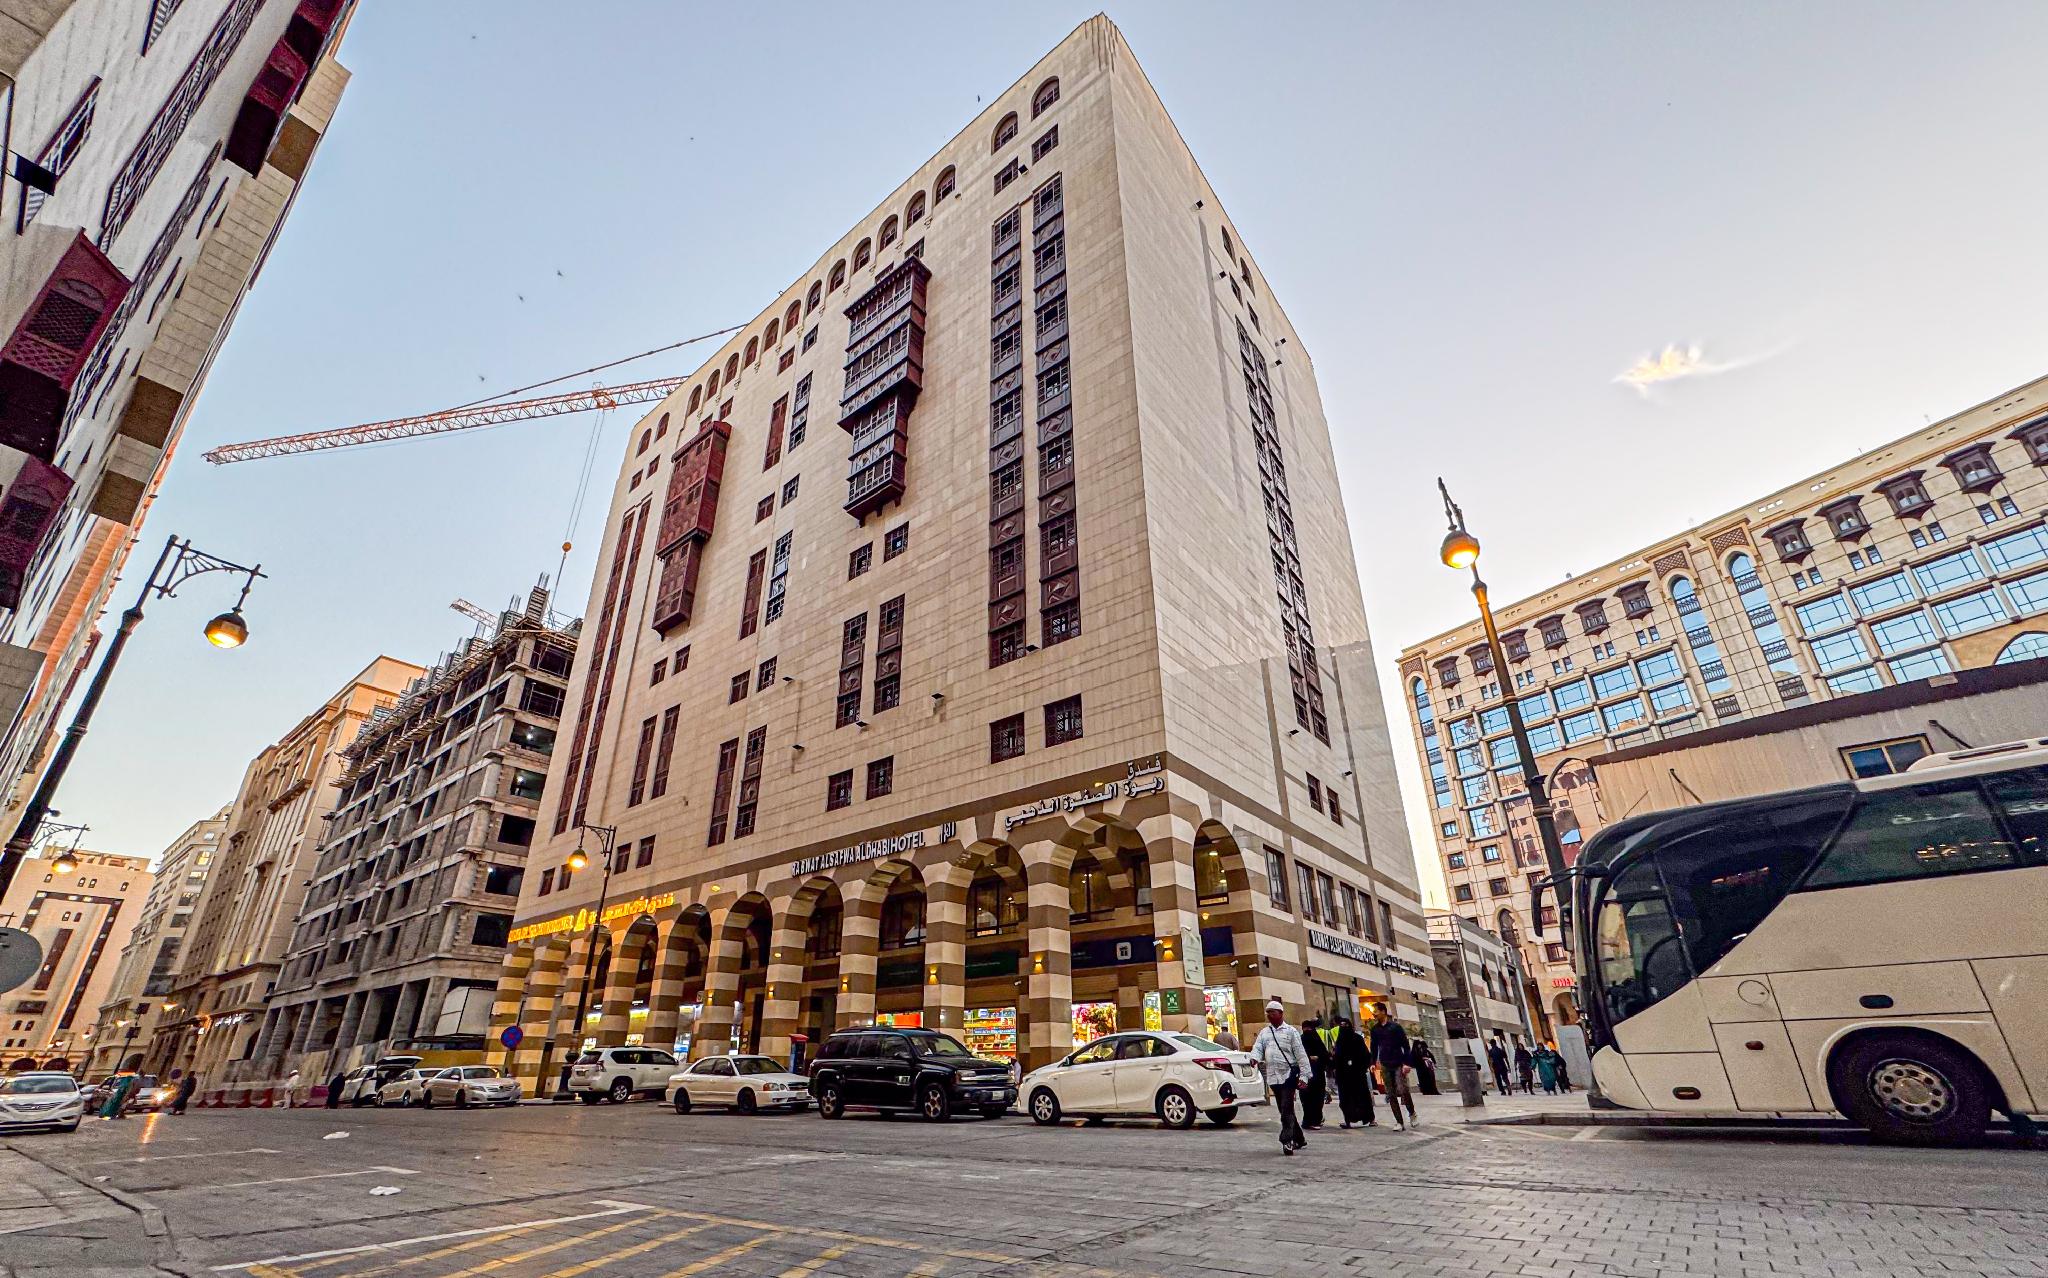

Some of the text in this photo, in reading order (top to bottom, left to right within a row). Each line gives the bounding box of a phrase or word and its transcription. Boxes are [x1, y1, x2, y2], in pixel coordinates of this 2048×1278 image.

[1127, 755, 1162, 780] فندق
[1005, 776, 1164, 831] ربوة الصفوة الذهبي
[791, 856, 820, 877] RABWAT
[820, 846, 855, 870] ALSAFWA
